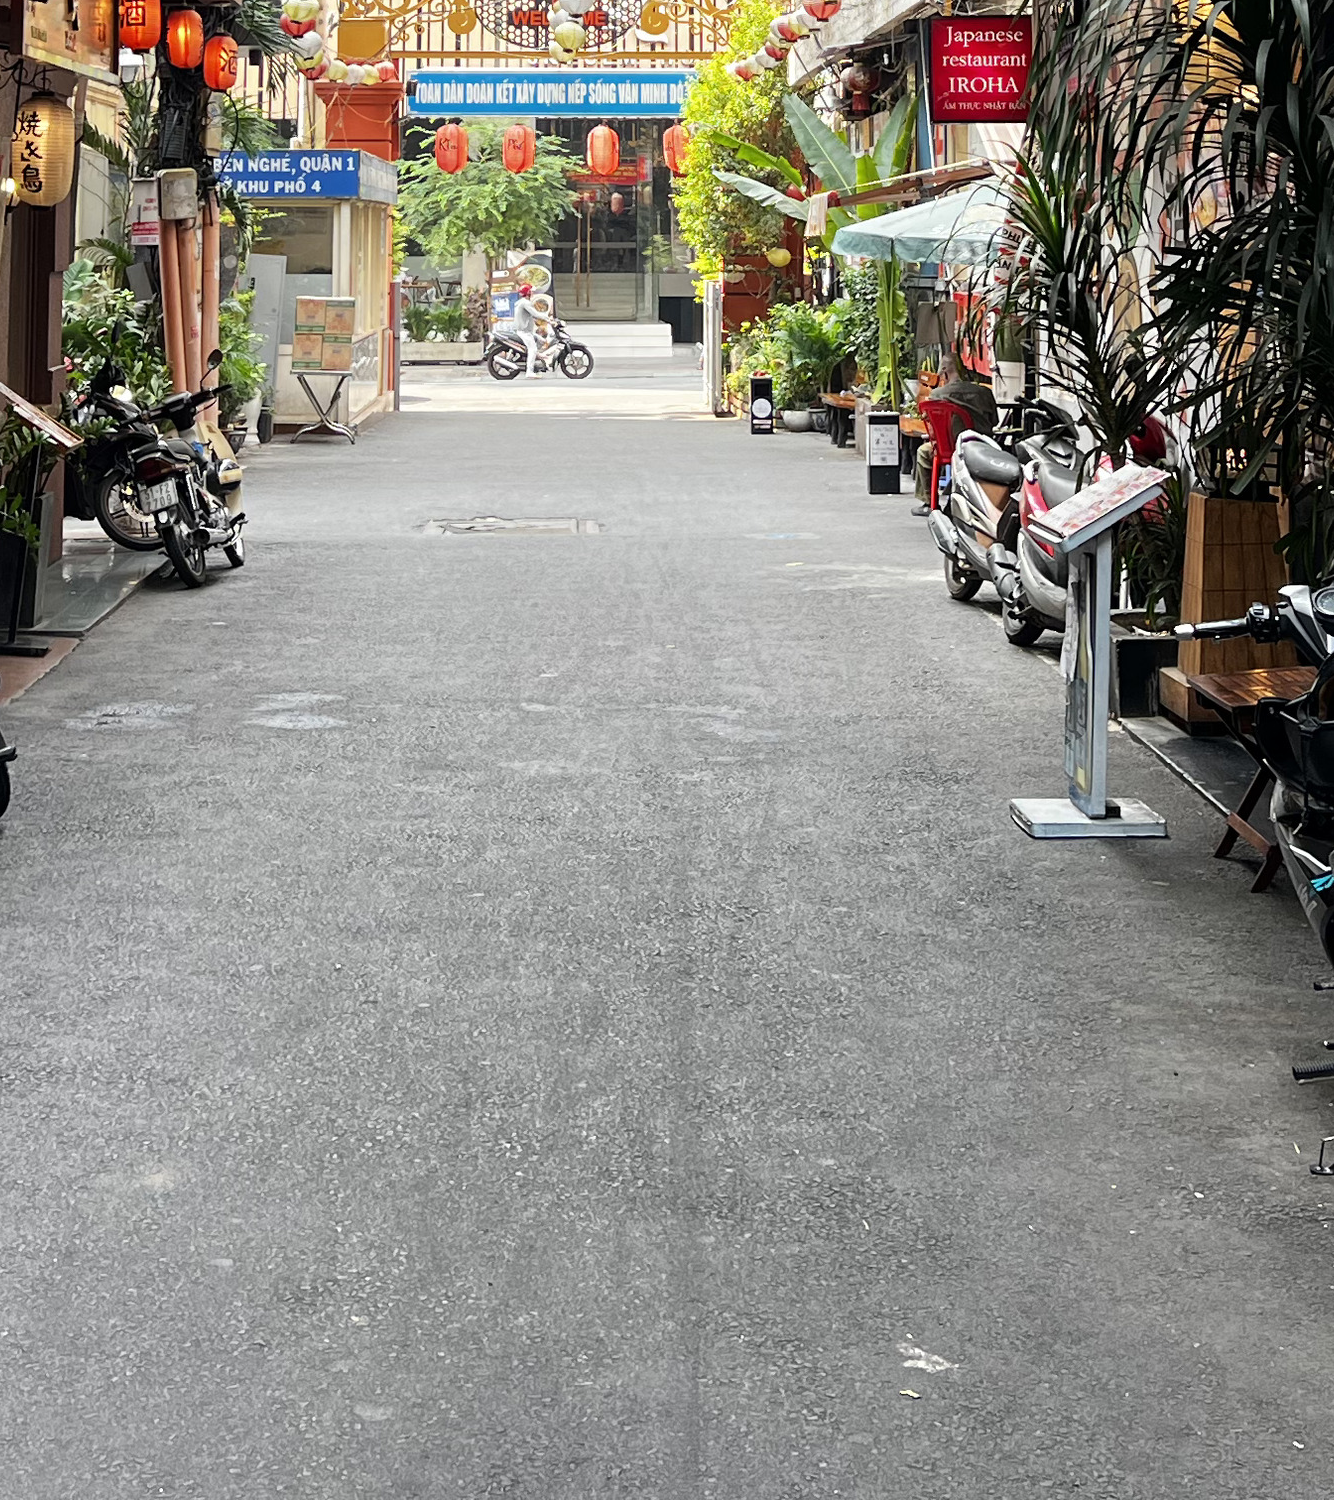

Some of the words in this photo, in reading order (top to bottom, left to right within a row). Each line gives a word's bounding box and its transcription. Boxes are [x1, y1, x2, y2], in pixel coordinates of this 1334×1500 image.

[511, 9, 608, 27] WELME
[943, 26, 1024, 48] Japanese
[942, 53, 1027, 67] restaurant
[443, 79, 464, 104] DÂN
[496, 78, 514, 104] KẾT
[516, 79, 537, 104] XÂY
[537, 81, 566, 107] DỰNG
[567, 78, 587, 104] NẾP
[589, 78, 617, 104] SỐNG
[618, 79, 639, 104] VĂN
[640, 82, 668, 104] MINH
[948, 76, 1019, 93] IROHA
[300, 153, 342, 174] QUẬN
[346, 156, 356, 172] 1
[236, 179, 270, 193] KHU
[274, 173, 307, 193] PHỐ
[310, 179, 322, 193] 4
